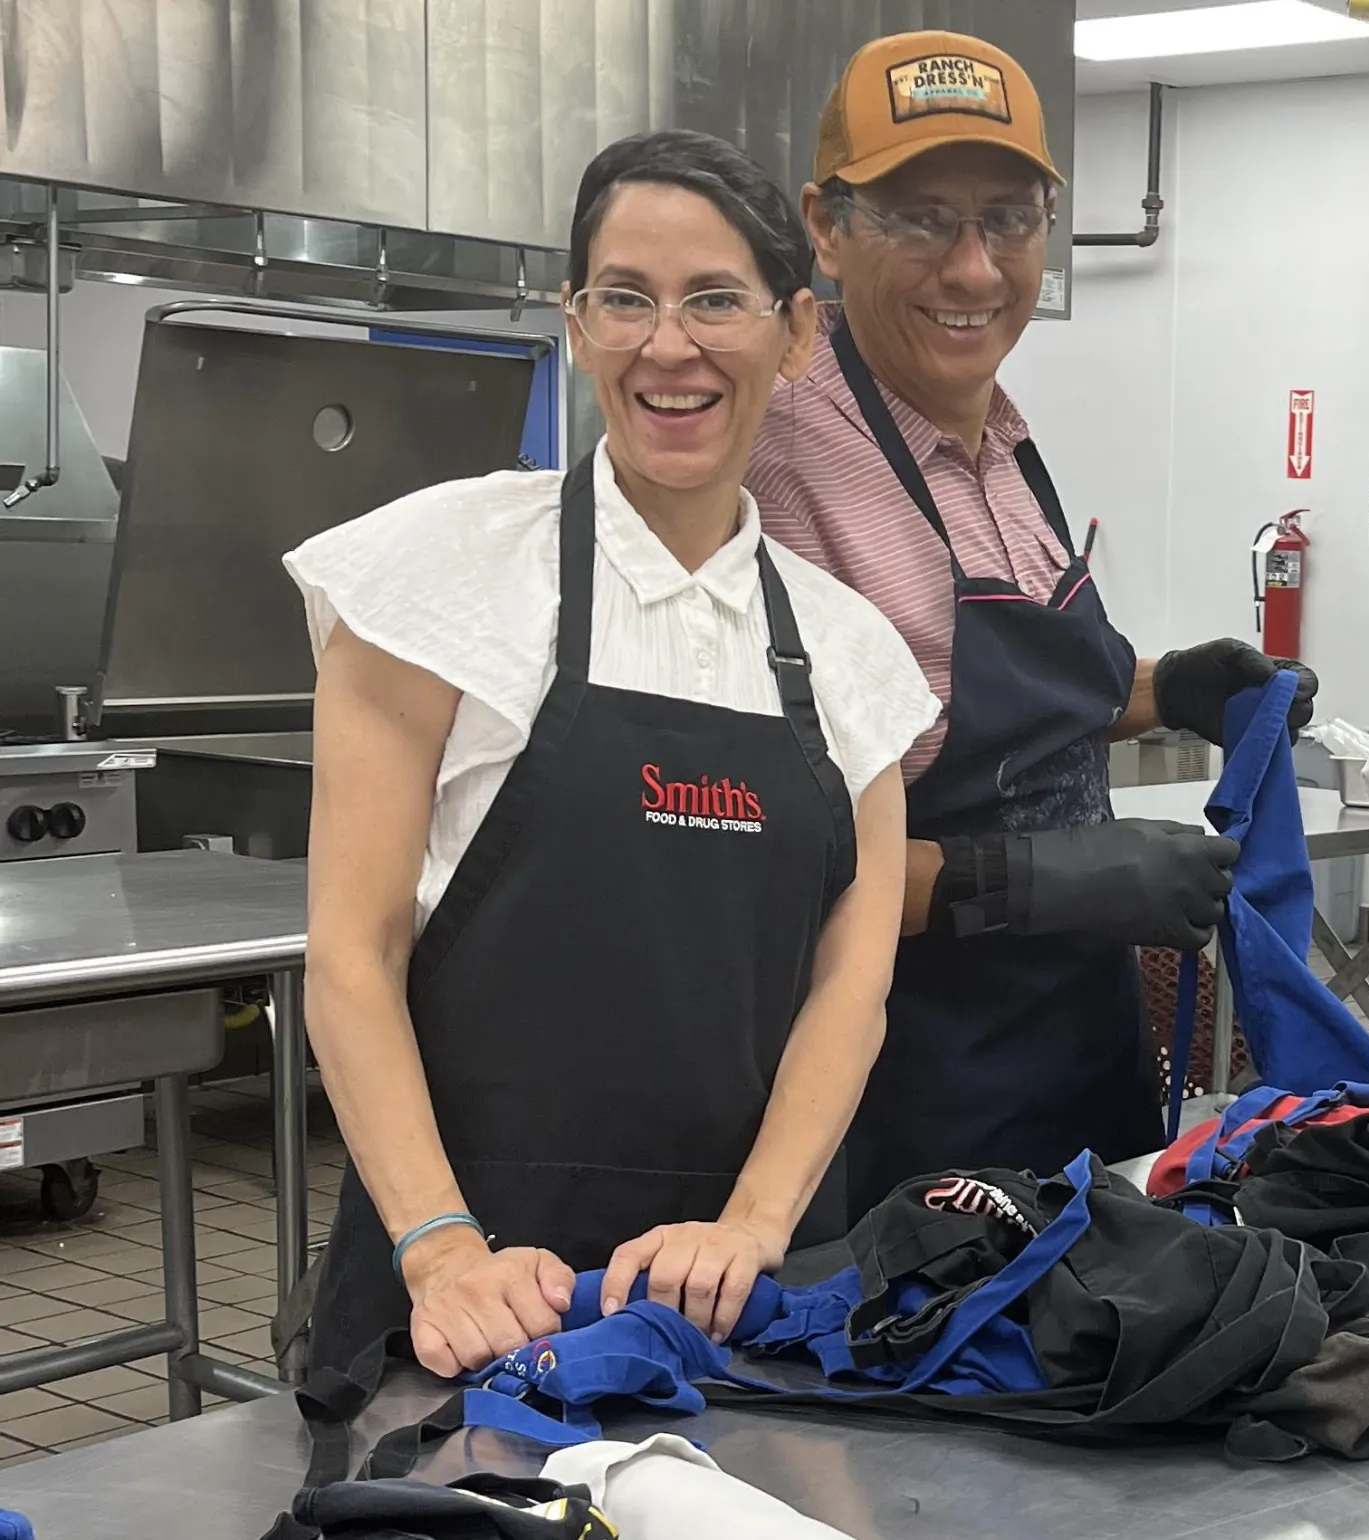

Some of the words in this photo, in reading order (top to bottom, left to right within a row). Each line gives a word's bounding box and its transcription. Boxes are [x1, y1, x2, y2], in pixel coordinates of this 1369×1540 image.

[918, 59, 974, 73] RANCH
[914, 71, 984, 89] DRESS'N
[641, 763, 766, 821] Smith's
[645, 810, 677, 825] FOOD
[678, 814, 687, 827] &
[688, 815, 720, 830] DRUG
[720, 819, 763, 833] STORES
